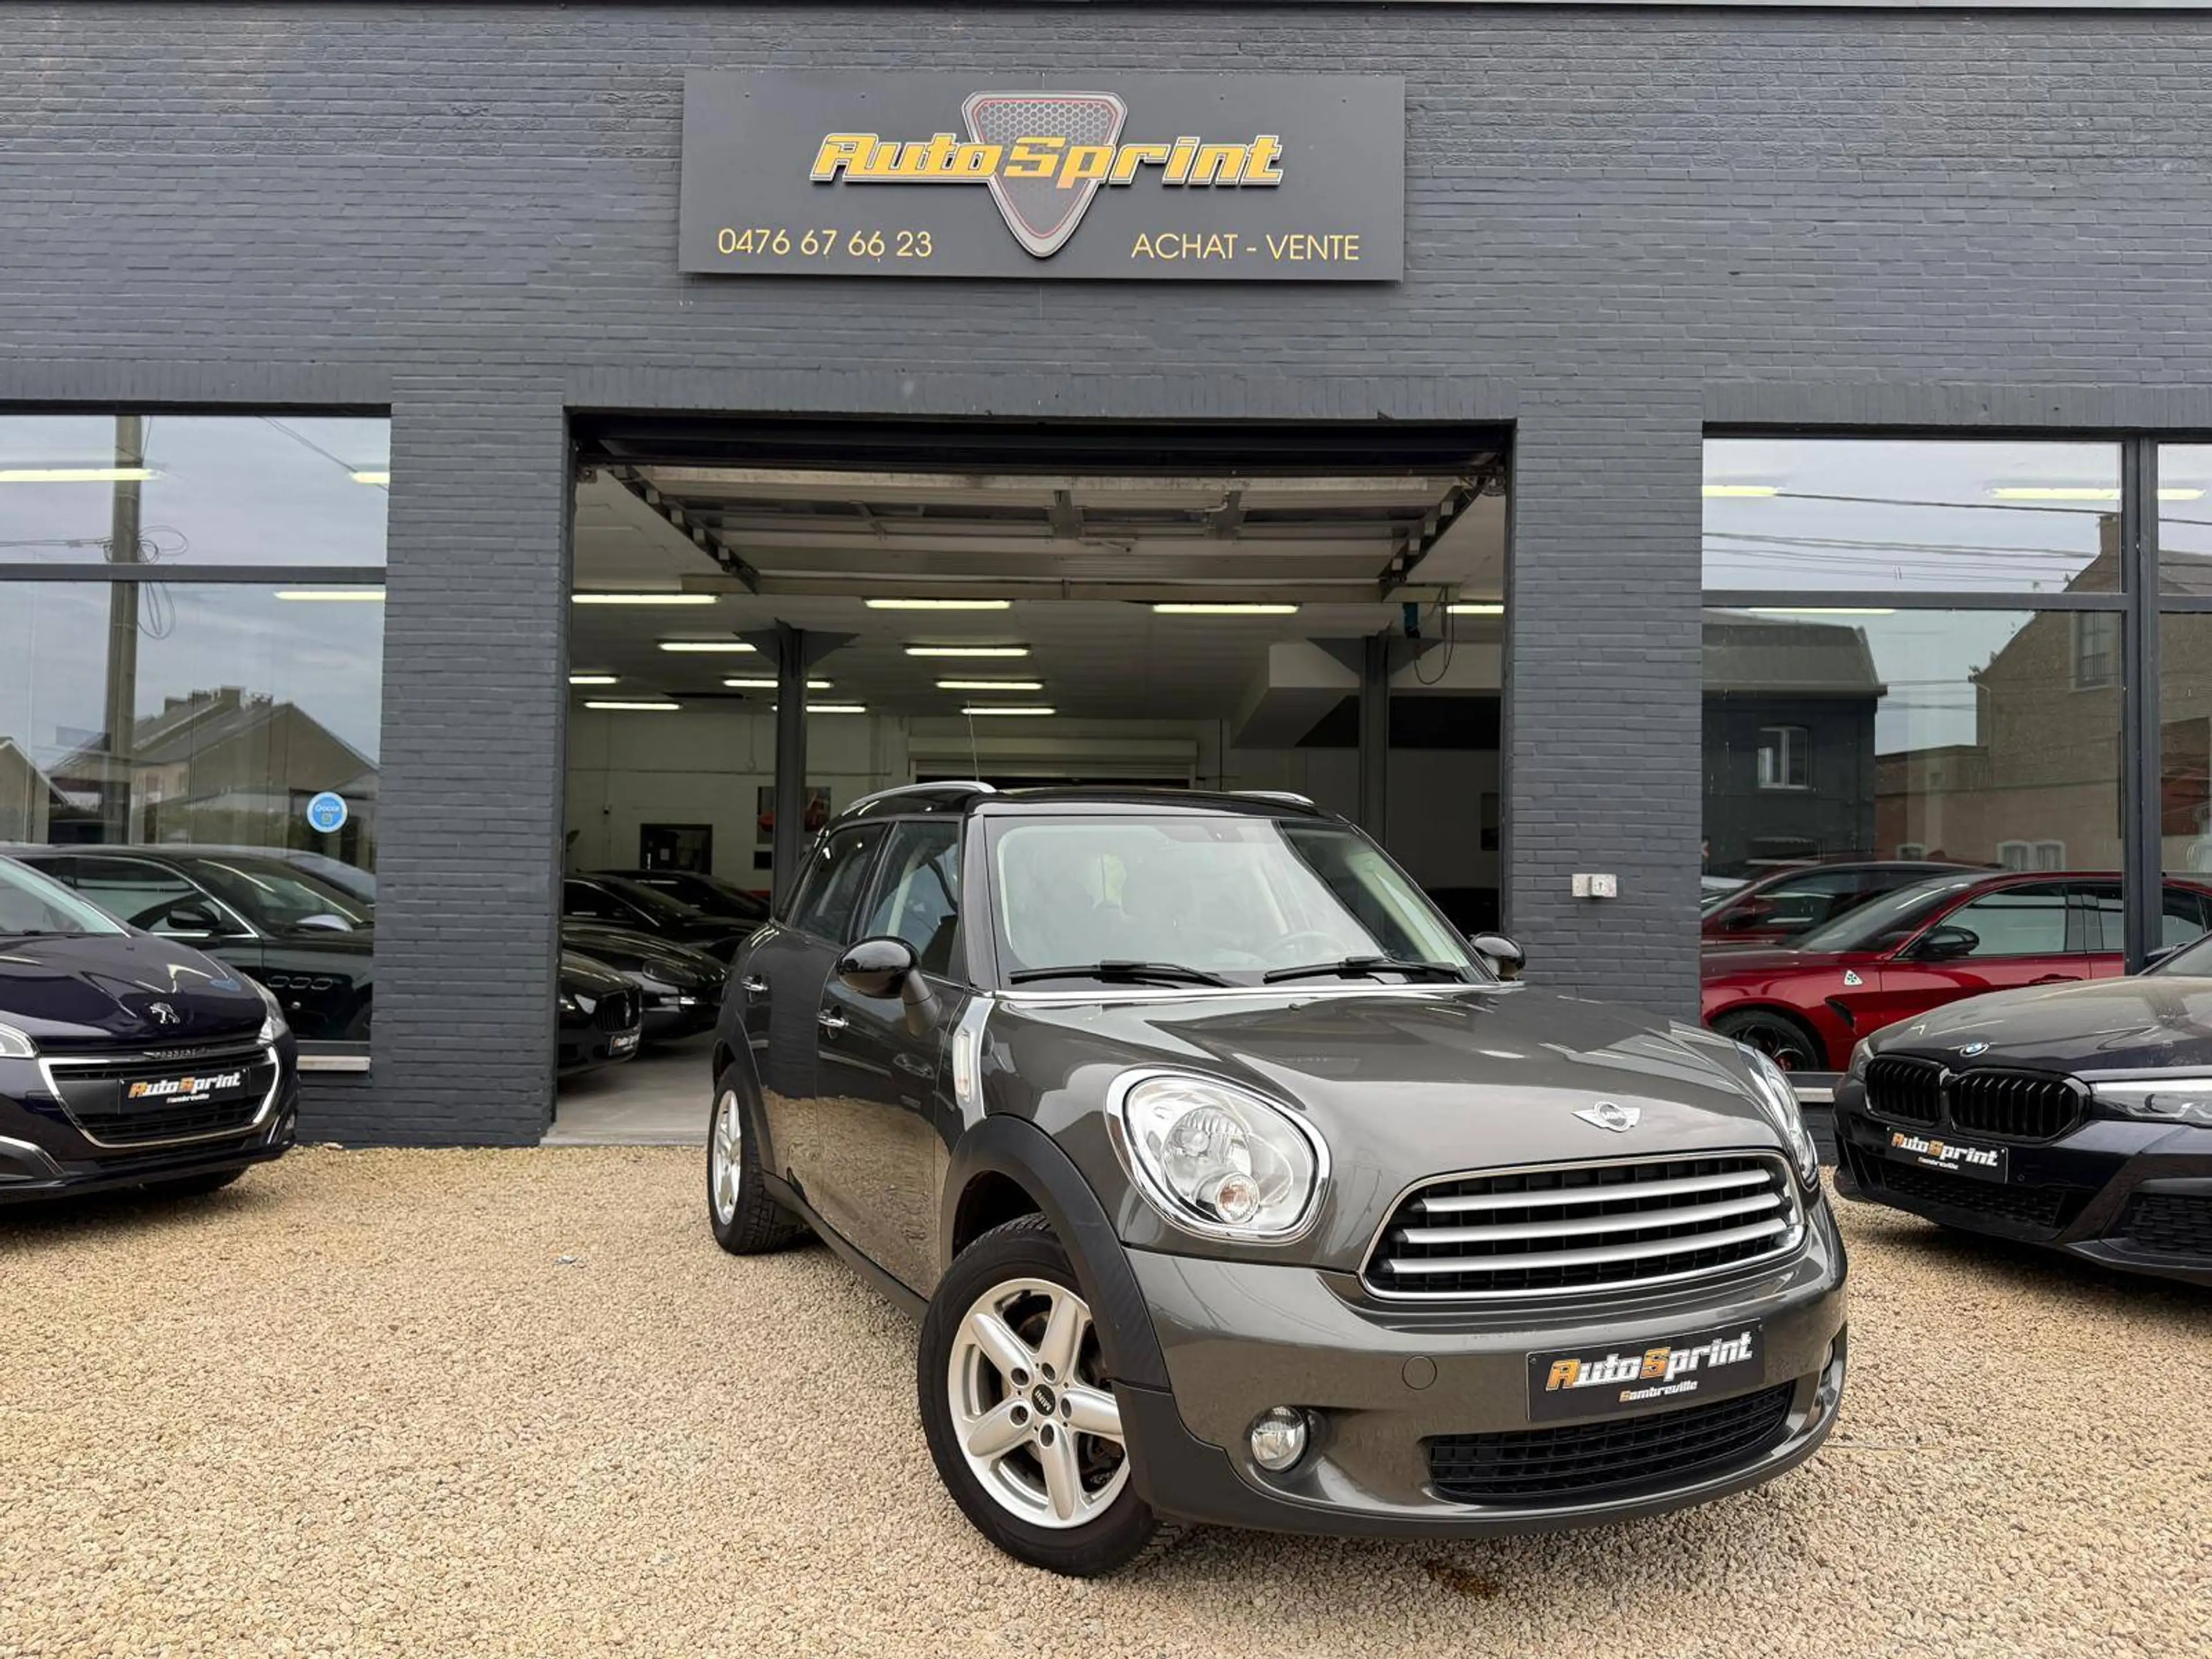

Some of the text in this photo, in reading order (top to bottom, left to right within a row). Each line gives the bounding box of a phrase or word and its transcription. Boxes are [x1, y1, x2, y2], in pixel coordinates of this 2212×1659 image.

[809, 132, 1283, 189] AutoSprint
[718, 228, 933, 257] 0476 67 66 23
[1130, 233, 1238, 259] ACHAT
[1266, 234, 1360, 260] VENTE
[128, 1072, 241, 1099] AutoSprint
[1891, 1132, 1998, 1167] AutoSprint
[1546, 1331, 1753, 1391] AutoSprint
